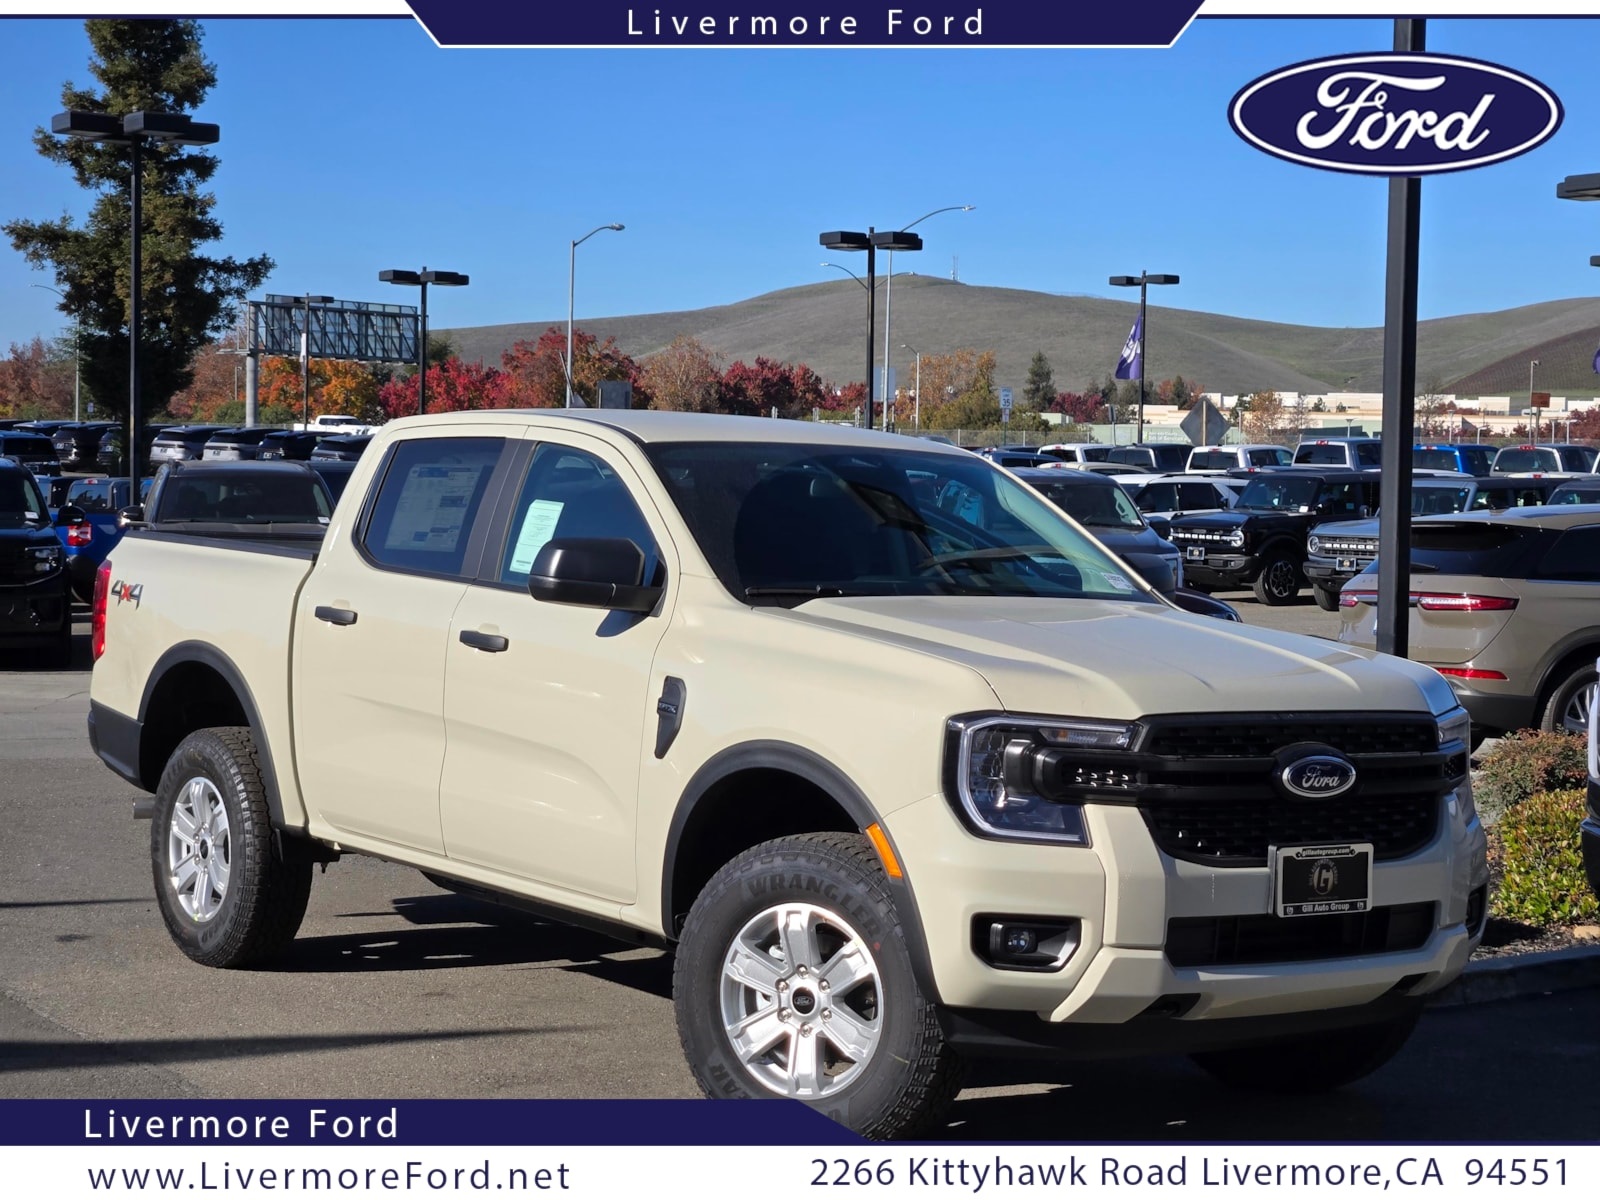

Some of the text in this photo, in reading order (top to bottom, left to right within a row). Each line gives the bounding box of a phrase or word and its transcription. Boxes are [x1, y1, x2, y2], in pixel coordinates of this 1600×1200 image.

[1302, 764, 1340, 788] Ford
[749, 873, 882, 939] WRANGLER
[1314, 904, 1330, 912] Auto
[1330, 903, 1350, 912] Group
